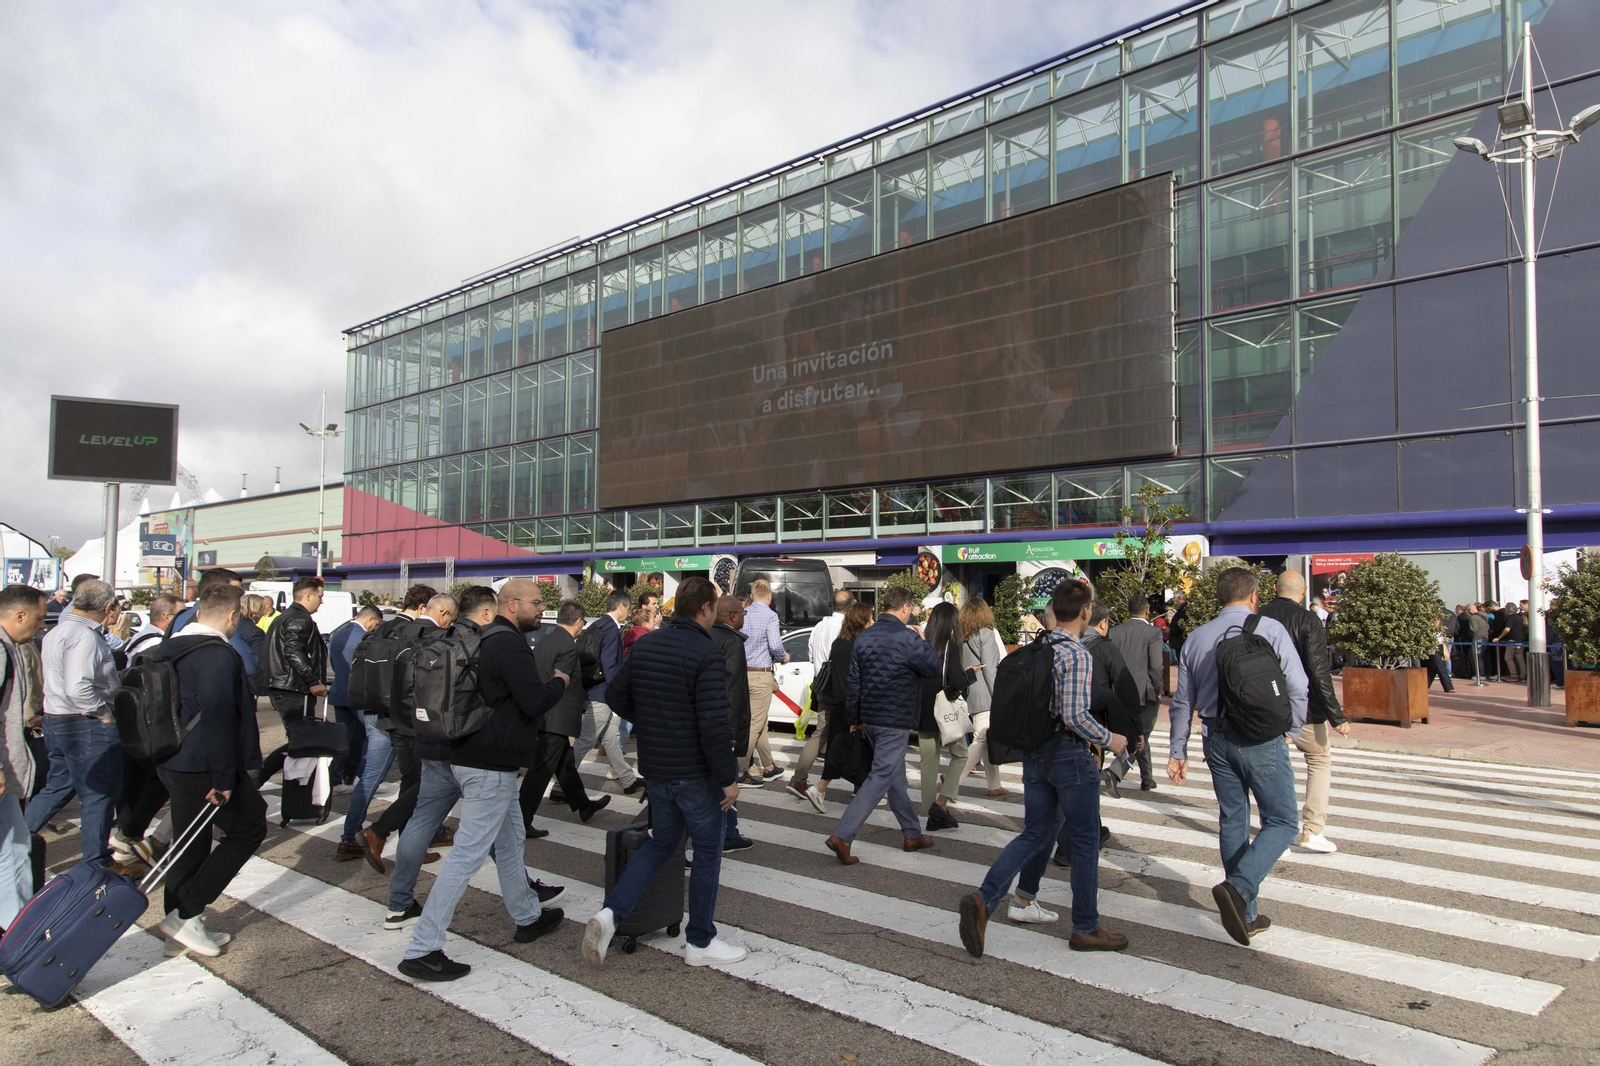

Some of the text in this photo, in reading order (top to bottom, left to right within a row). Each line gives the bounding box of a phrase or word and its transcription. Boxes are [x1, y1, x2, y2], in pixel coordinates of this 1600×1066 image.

[752, 341, 894, 384] Una invitación
[762, 382, 881, 413] a disfrutar...
